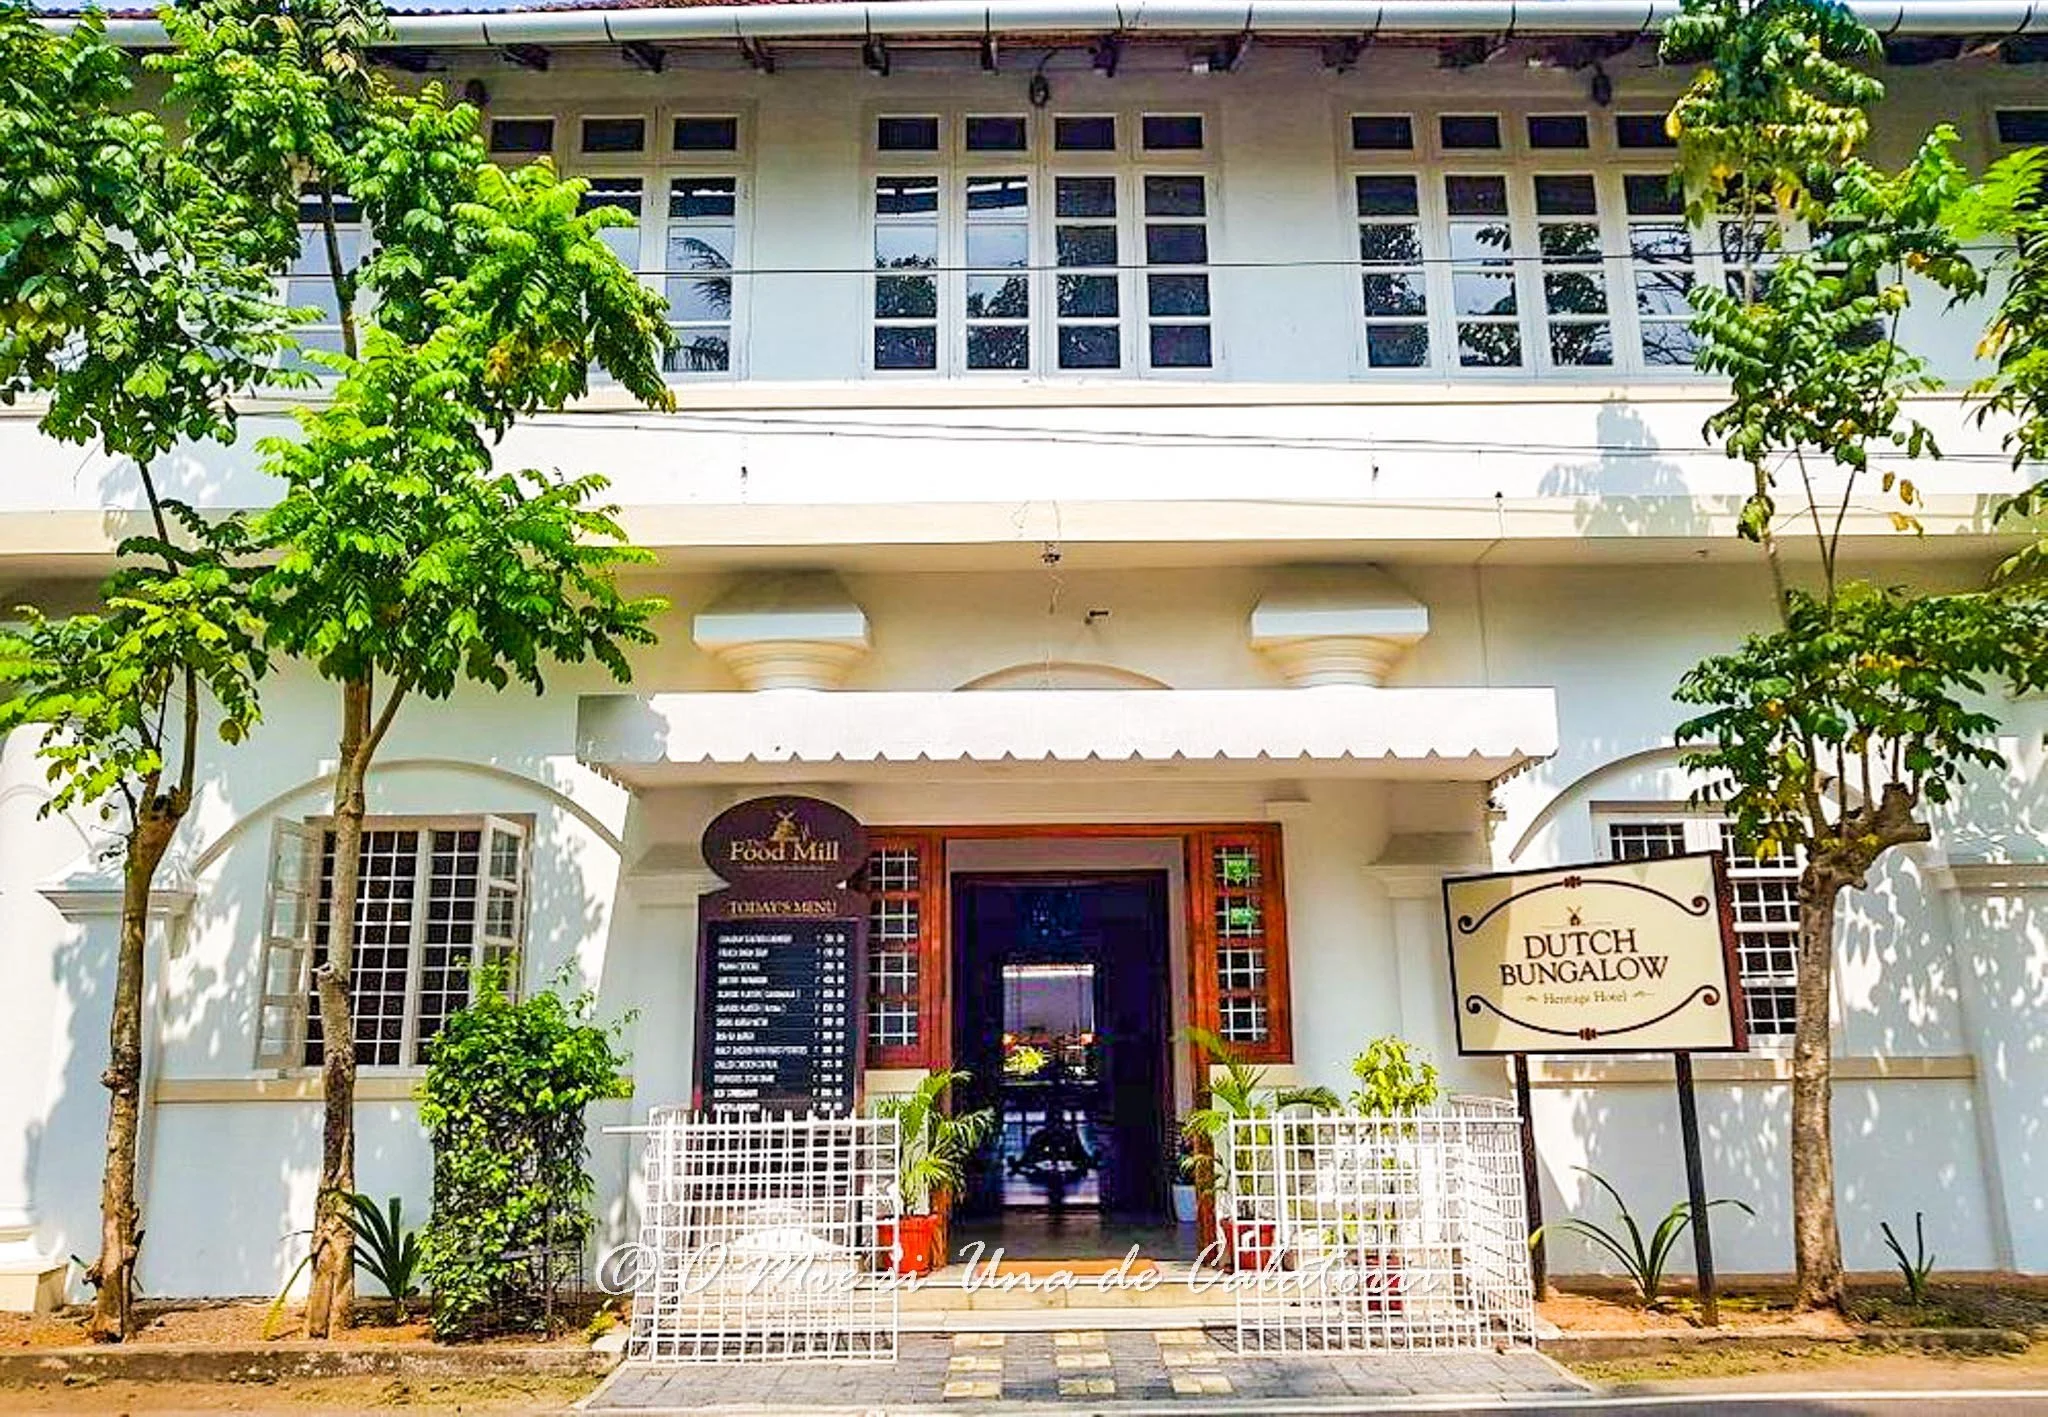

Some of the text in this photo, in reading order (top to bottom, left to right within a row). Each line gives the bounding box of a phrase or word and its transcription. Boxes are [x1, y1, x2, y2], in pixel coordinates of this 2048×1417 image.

[730, 841, 785, 861] Food
[793, 840, 839, 861] Mill
[794, 901, 837, 914] MENU
[1524, 928, 1639, 960] DUTCH
[1500, 956, 1669, 986] BUNGALOW
[1543, 990, 1627, 1006] Heritage Hotel
